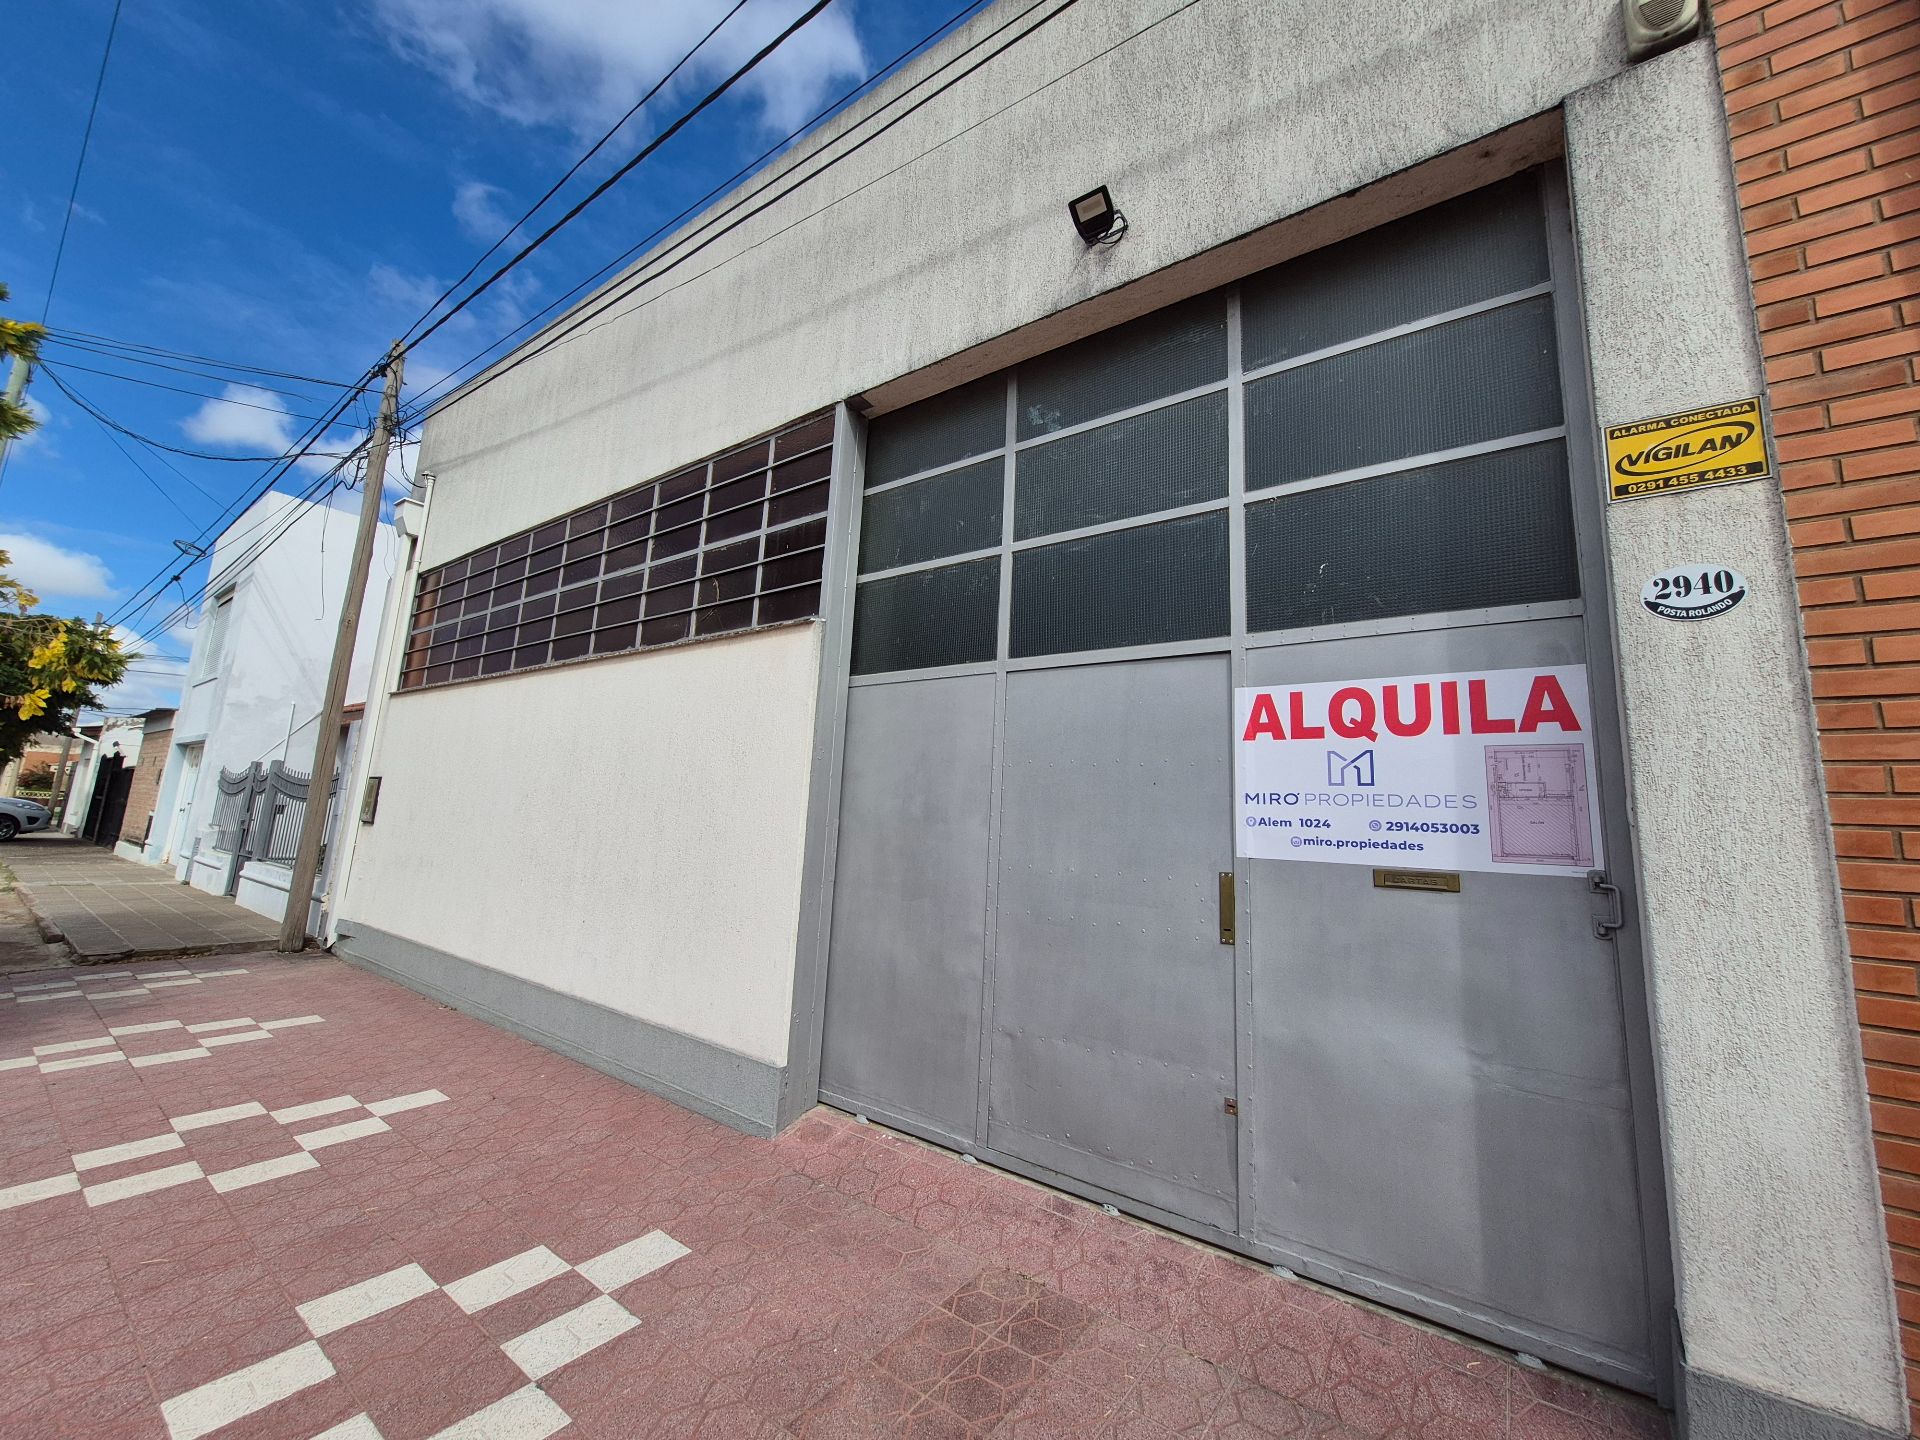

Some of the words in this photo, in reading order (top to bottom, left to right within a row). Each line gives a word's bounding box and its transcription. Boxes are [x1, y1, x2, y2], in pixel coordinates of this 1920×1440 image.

[1613, 422, 1667, 438] ALARMA
[1672, 404, 1751, 426] CONECTADA
[1620, 433, 1743, 468] VIGILAN
[1628, 481, 1666, 493] 0291
[1669, 473, 1700, 486] 455
[1704, 465, 1748, 480] 4433
[1652, 569, 1734, 601] 2940
[1657, 605, 1687, 617] POSTA
[1689, 598, 1733, 617] ROLANDO
[1242, 674, 1583, 743] ALQUILA
[1304, 792, 1478, 809] PROPIEDADES
[1257, 816, 1292, 828] Alem
[1298, 818, 1332, 829] 1024
[1385, 821, 1480, 835] 2914053003
[1303, 835, 1424, 852] miro.propiedades
